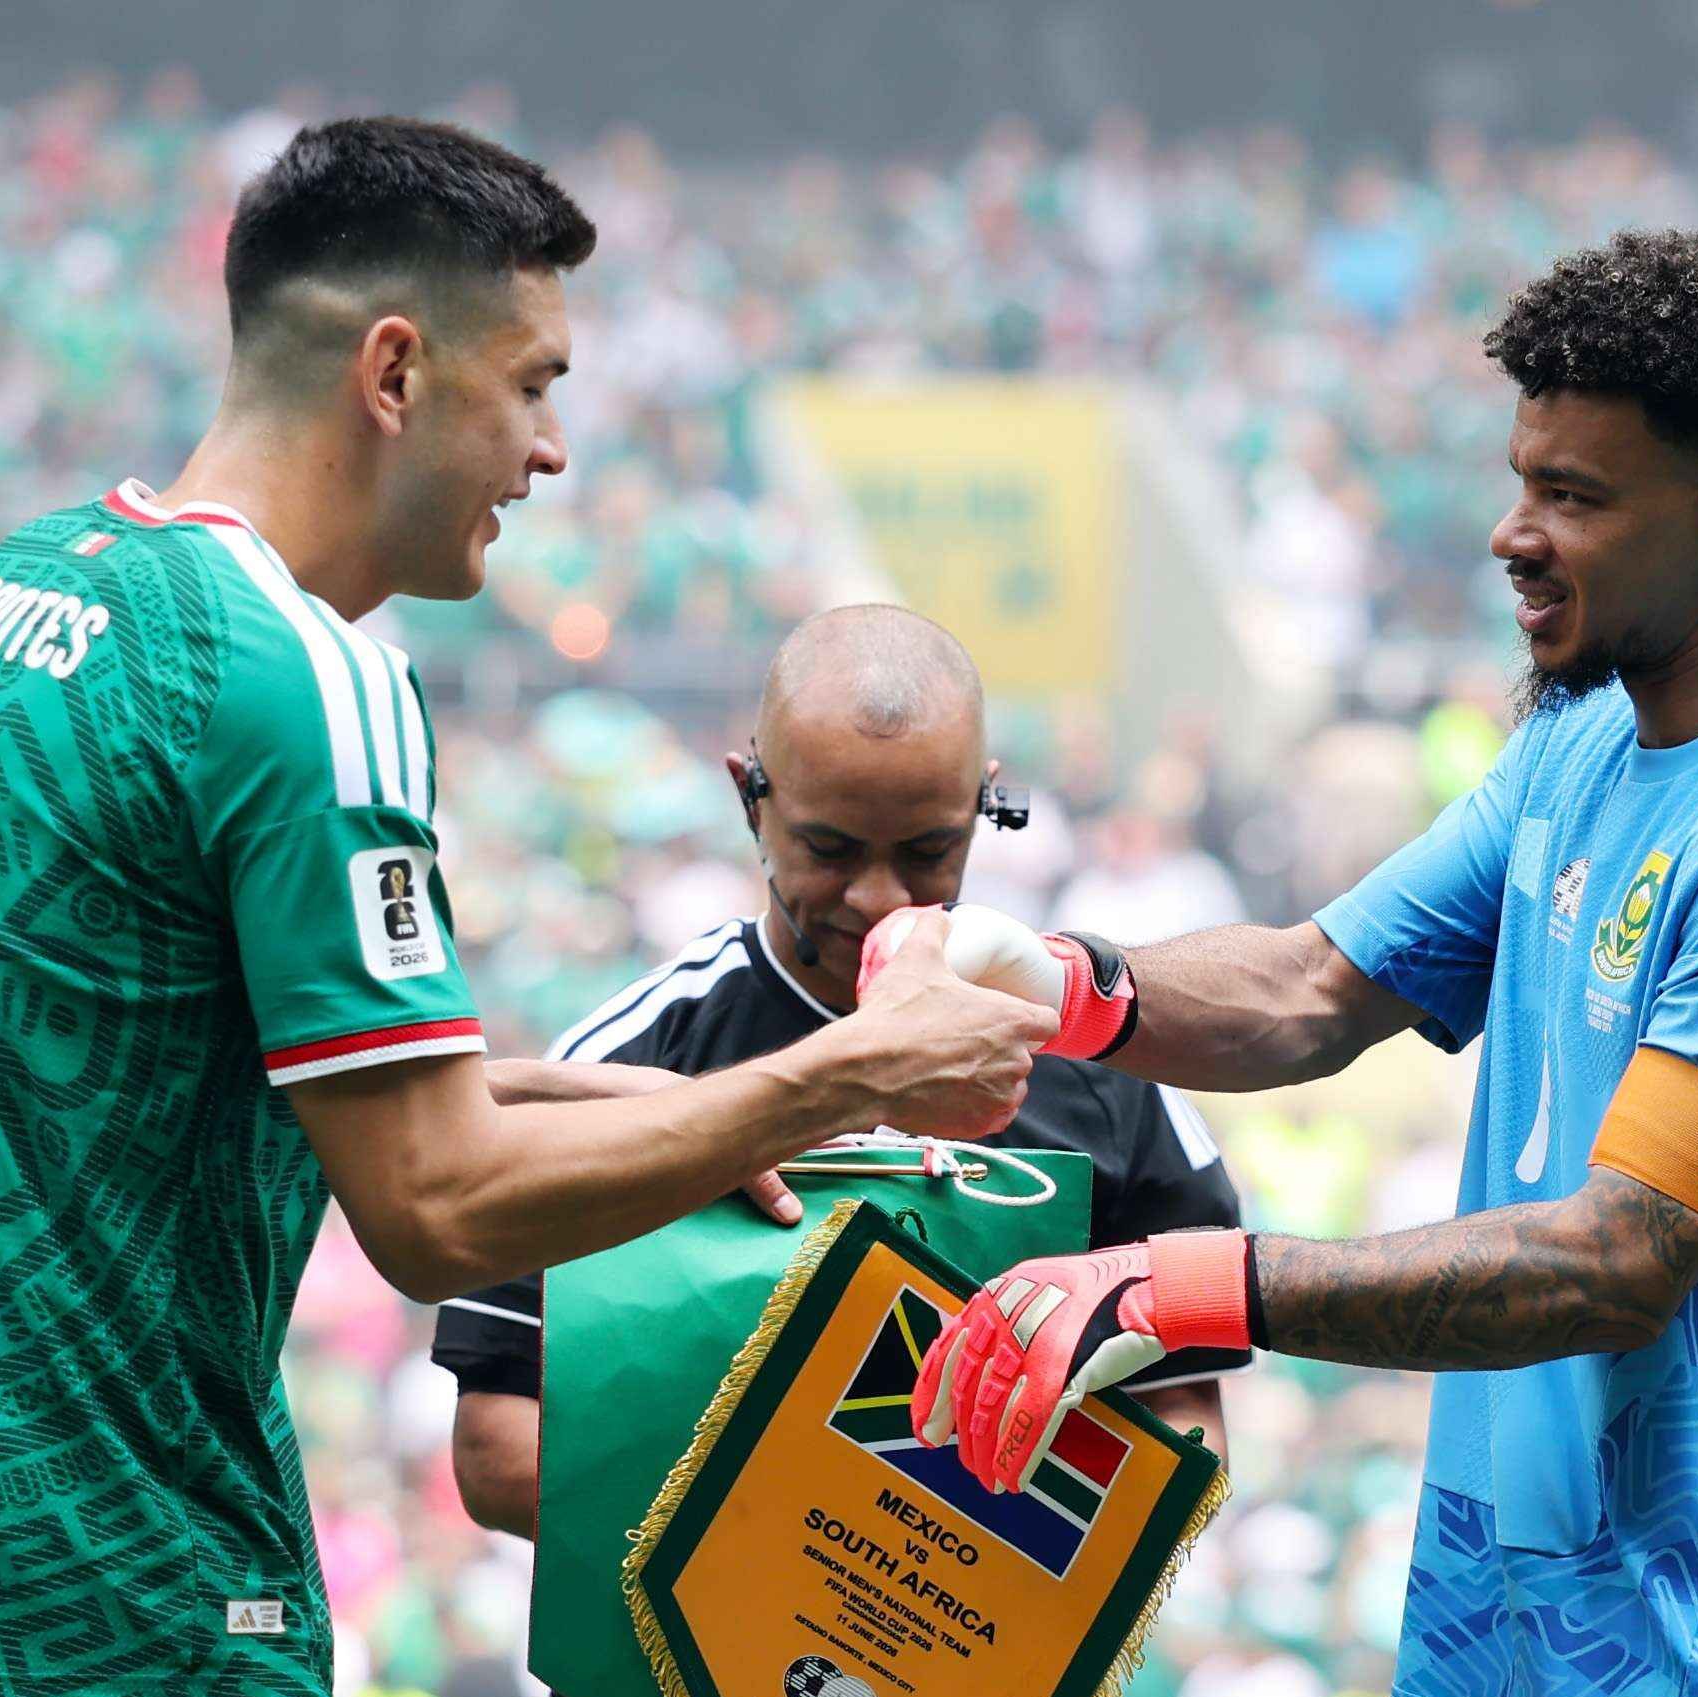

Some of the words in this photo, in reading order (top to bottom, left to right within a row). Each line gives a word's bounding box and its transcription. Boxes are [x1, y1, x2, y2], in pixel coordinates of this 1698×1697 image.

[390, 952, 429, 967] 2026
[875, 1488, 979, 1566] MEXICO
[904, 1538, 930, 1564] VS
[802, 1544, 848, 1577] SENIOR
[846, 1570, 883, 1600] MEN'S
[883, 1594, 938, 1637] NATIONAL
[939, 1631, 972, 1659] TEAM
[803, 1508, 900, 1578] SOUTH
[898, 1571, 996, 1645] AFRICA
[824, 1577, 848, 1598] FIFA
[847, 1591, 887, 1623] WORLD
[886, 1616, 910, 1636] CUP
[794, 1613, 828, 1638] ESTADIO
[867, 1659, 898, 1683] MEXICO
[896, 1679, 916, 1694] CITY
[835, 1613, 849, 1626] 11
[848, 1621, 876, 1644] JUNE
[874, 1638, 899, 1658] 2026
